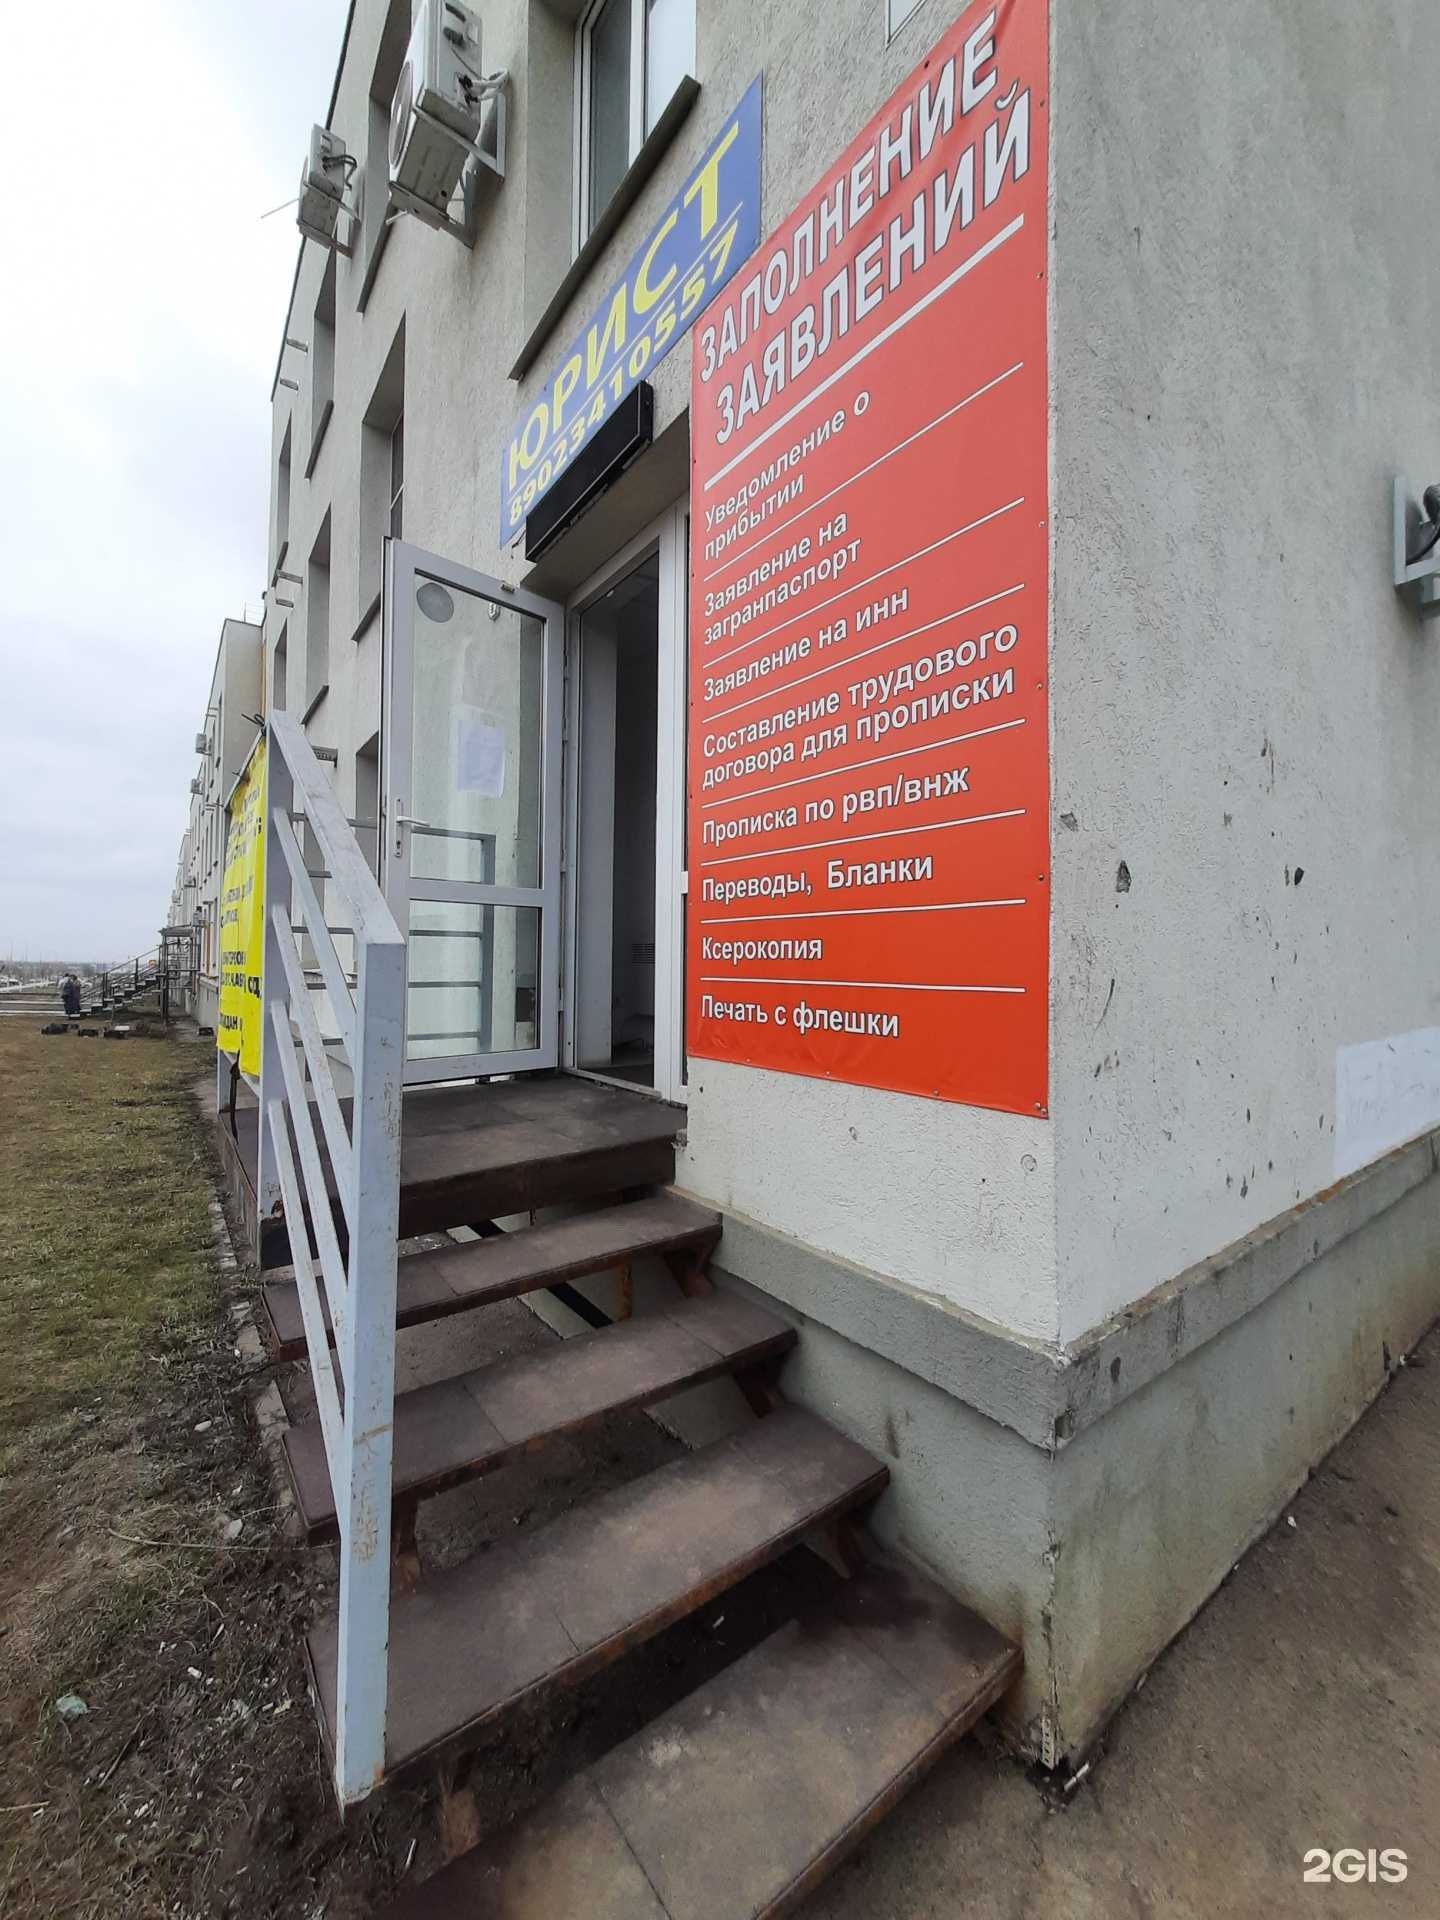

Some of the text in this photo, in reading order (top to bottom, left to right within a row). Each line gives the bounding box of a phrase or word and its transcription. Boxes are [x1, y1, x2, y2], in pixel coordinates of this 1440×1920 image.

[701, 8, 997, 383] ЗАПОЛНЕНИЕ
[509, 121, 739, 491] ЮРИСТ
[716, 80, 1030, 445] ЗАЯВЛЕНИЙ
[510, 220, 738, 527] 89023410557
[704, 474, 804, 560] прибытии
[705, 391, 870, 532] Уведомление о
[704, 512, 848, 616] Заявление на
[704, 539, 861, 645] загранпаспорт
[703, 624, 1018, 758] Составление трудового
[704, 588, 908, 701] Заявление на инн
[703, 668, 1014, 790] договора для прописки
[703, 767, 969, 846] Прописка по рвп/внж
[702, 856, 933, 904] Переводы, Бланки
[702, 937, 822, 964] Ксерокопия
[701, 995, 899, 1037] Печать с флешки
